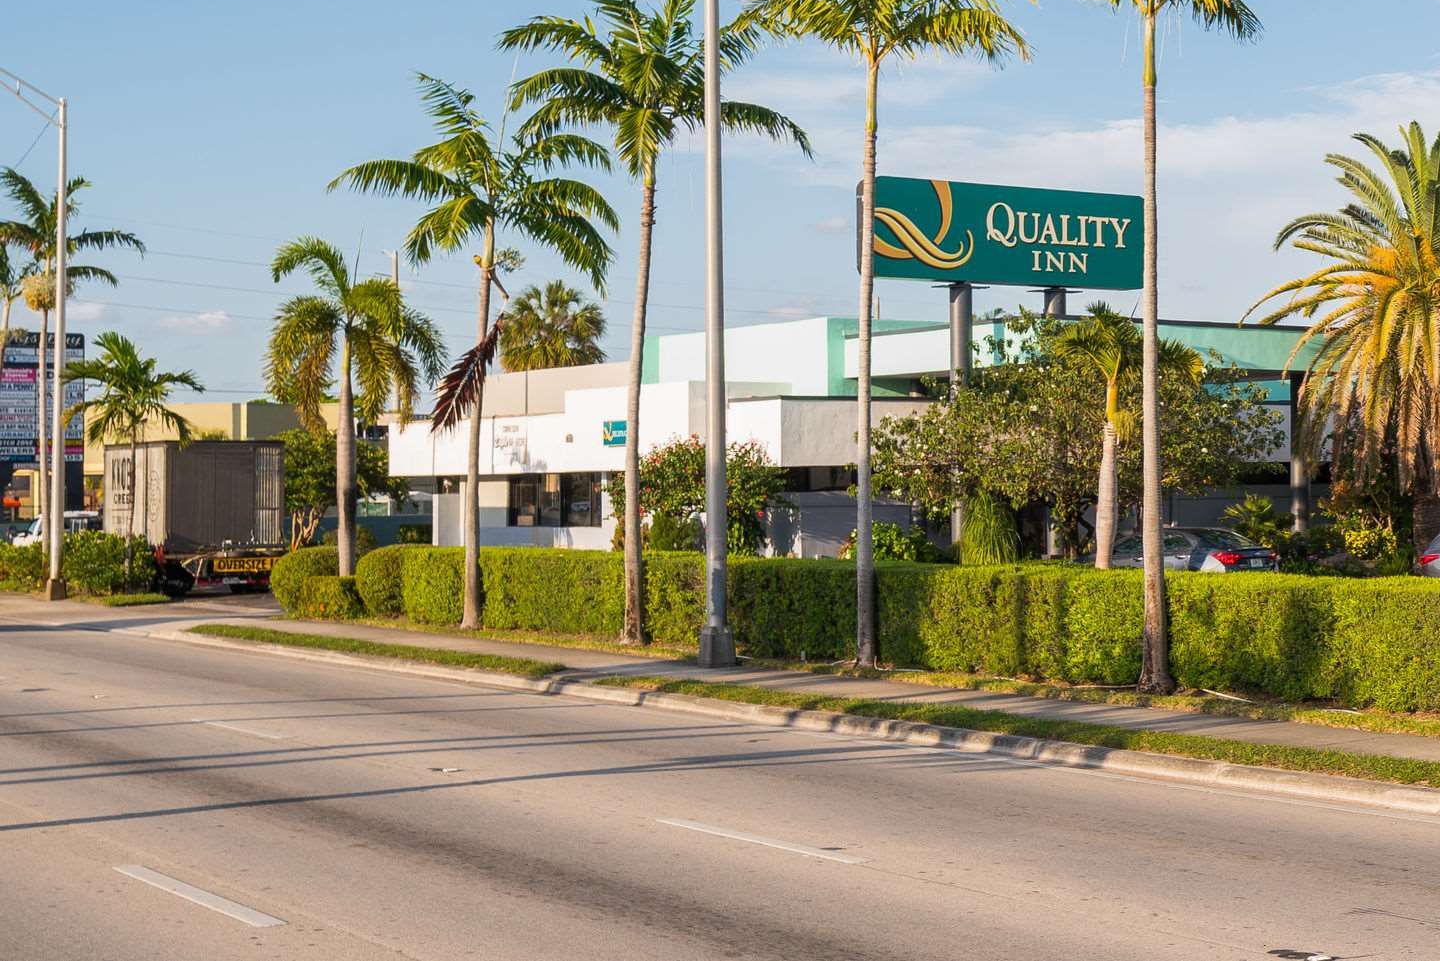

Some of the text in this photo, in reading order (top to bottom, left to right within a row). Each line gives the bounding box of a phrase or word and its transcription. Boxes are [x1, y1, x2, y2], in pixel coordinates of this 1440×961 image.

[986, 202, 1131, 248] QUALITY
[1031, 250, 1089, 274] INN
[113, 493, 133, 505] CREE
[217, 558, 268, 570] OVERSIZE
